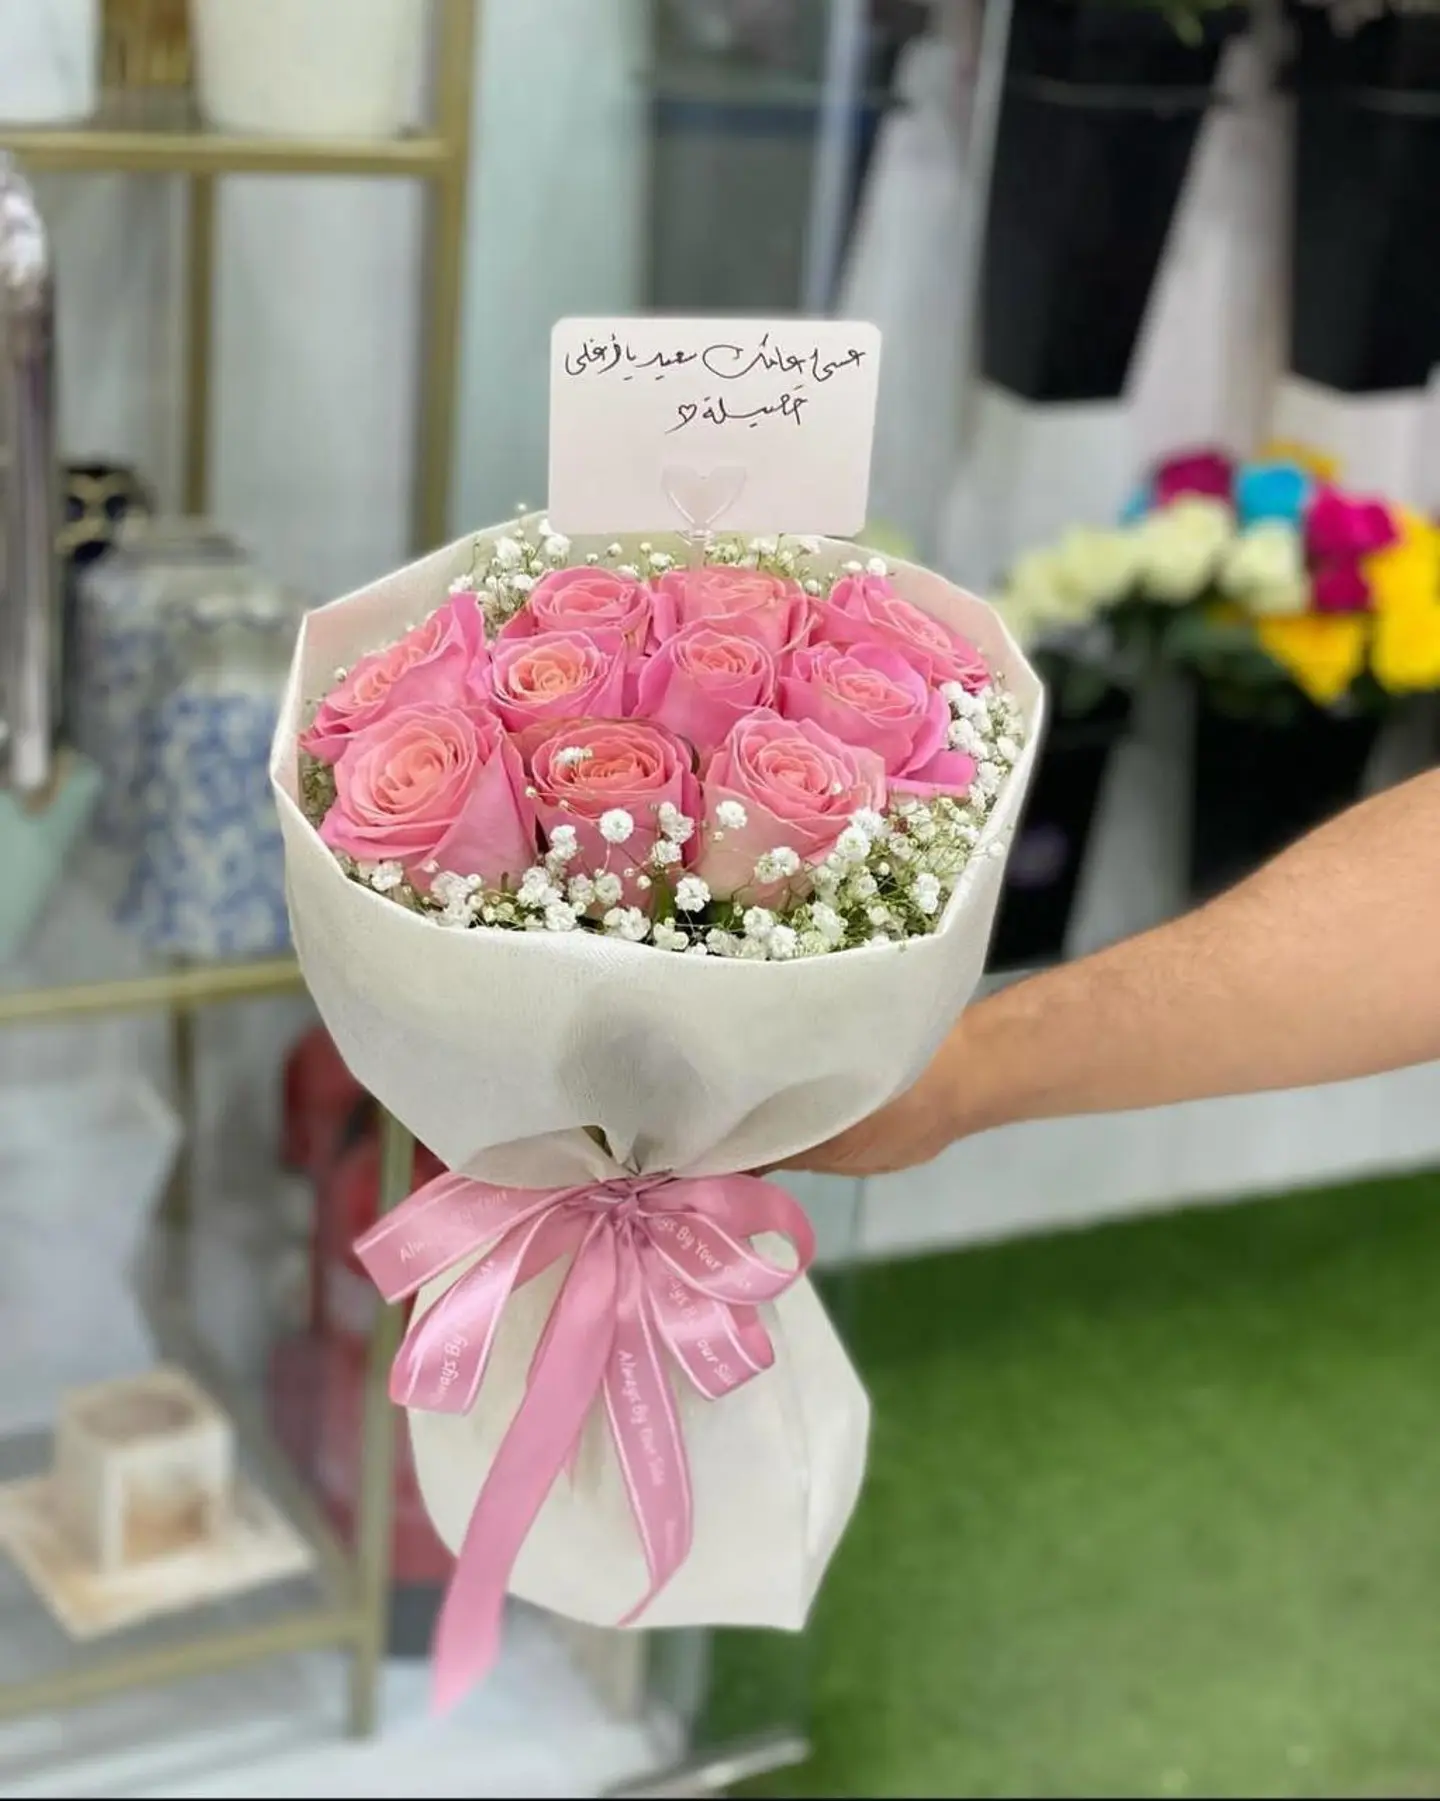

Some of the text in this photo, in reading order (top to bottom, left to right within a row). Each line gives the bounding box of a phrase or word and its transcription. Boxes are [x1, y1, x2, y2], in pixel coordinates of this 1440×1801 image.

[636, 350, 698, 381] سعيد
[675, 1226, 695, 1251] By
[694, 1240, 723, 1272] Your
